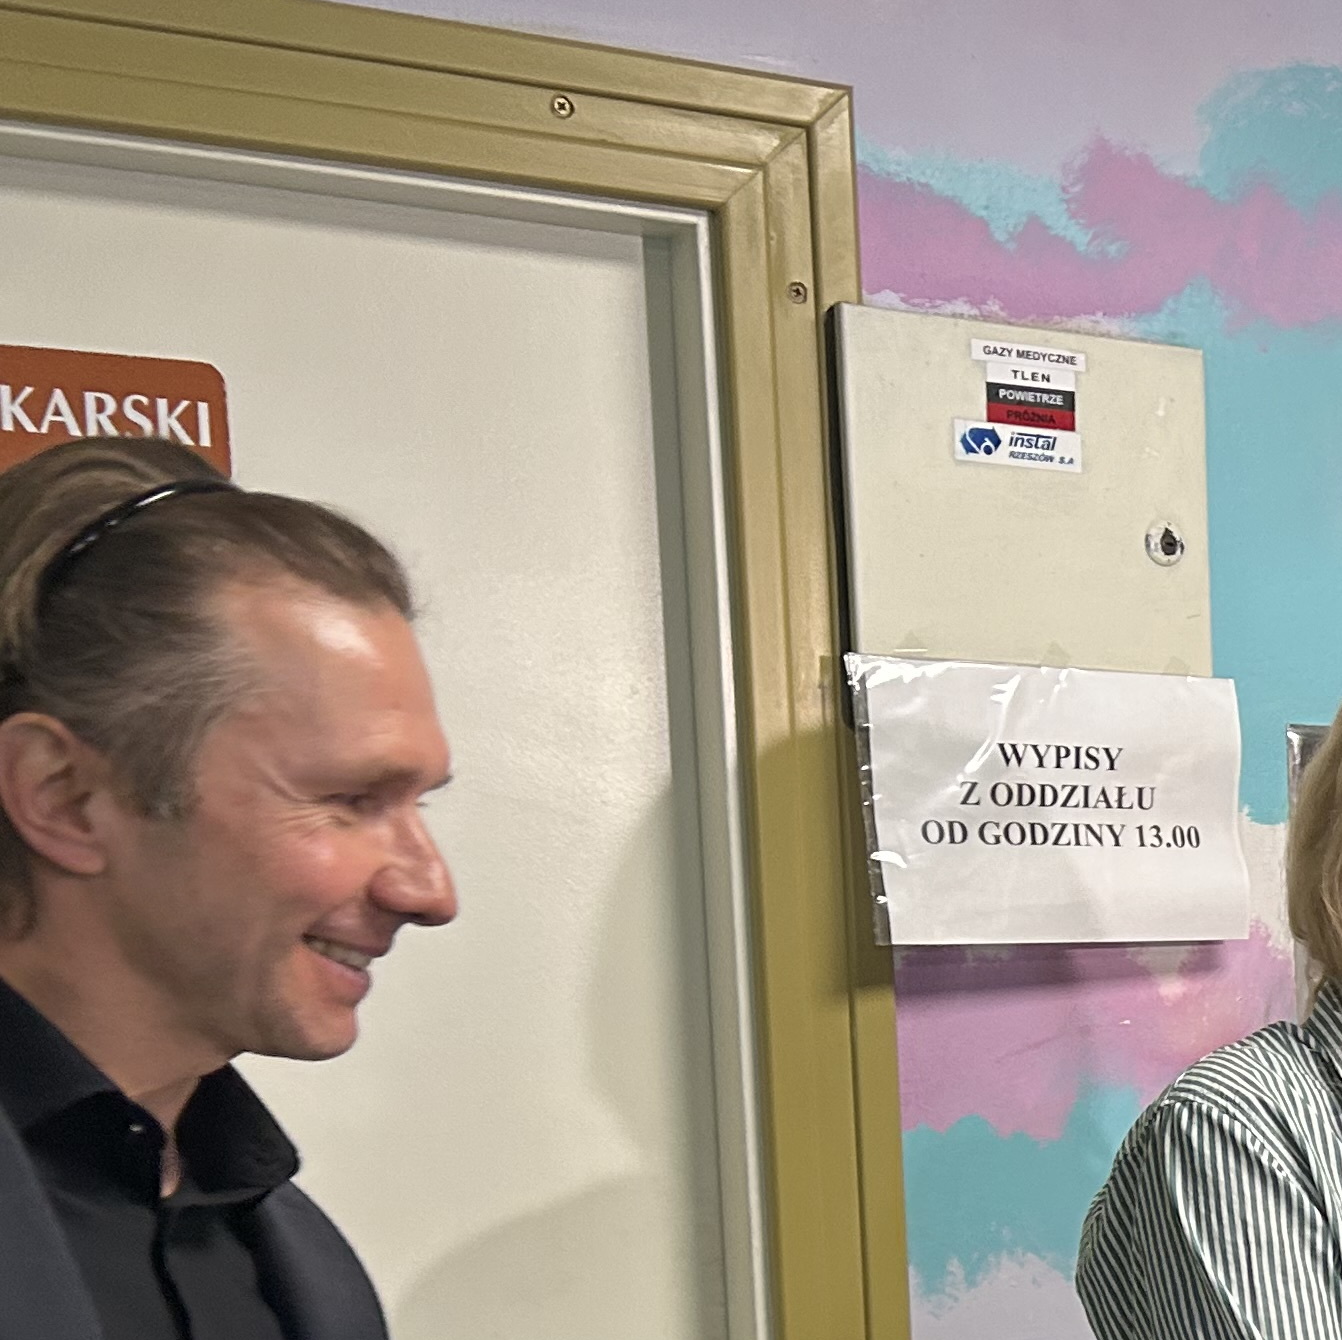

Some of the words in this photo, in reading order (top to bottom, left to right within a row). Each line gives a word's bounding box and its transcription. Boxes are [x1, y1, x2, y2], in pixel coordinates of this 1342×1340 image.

[982, 345, 1014, 358] GAZY
[1016, 349, 1078, 366] MEDYCZNE
[1011, 369, 1051, 383] TLEN
[998, 388, 1064, 406] POWIETRZE
[1006, 408, 1057, 425] PRÓŻNIA
[1008, 431, 1058, 452] instal
[1008, 450, 1054, 463] RZESZÓW
[997, 742, 1123, 771] WYPISY
[959, 781, 981, 806] Z
[990, 781, 1156, 811] ODDZIAŁU
[921, 819, 968, 846] OD
[978, 820, 1126, 848] GODZINY
[1136, 824, 1201, 849] 13.00
